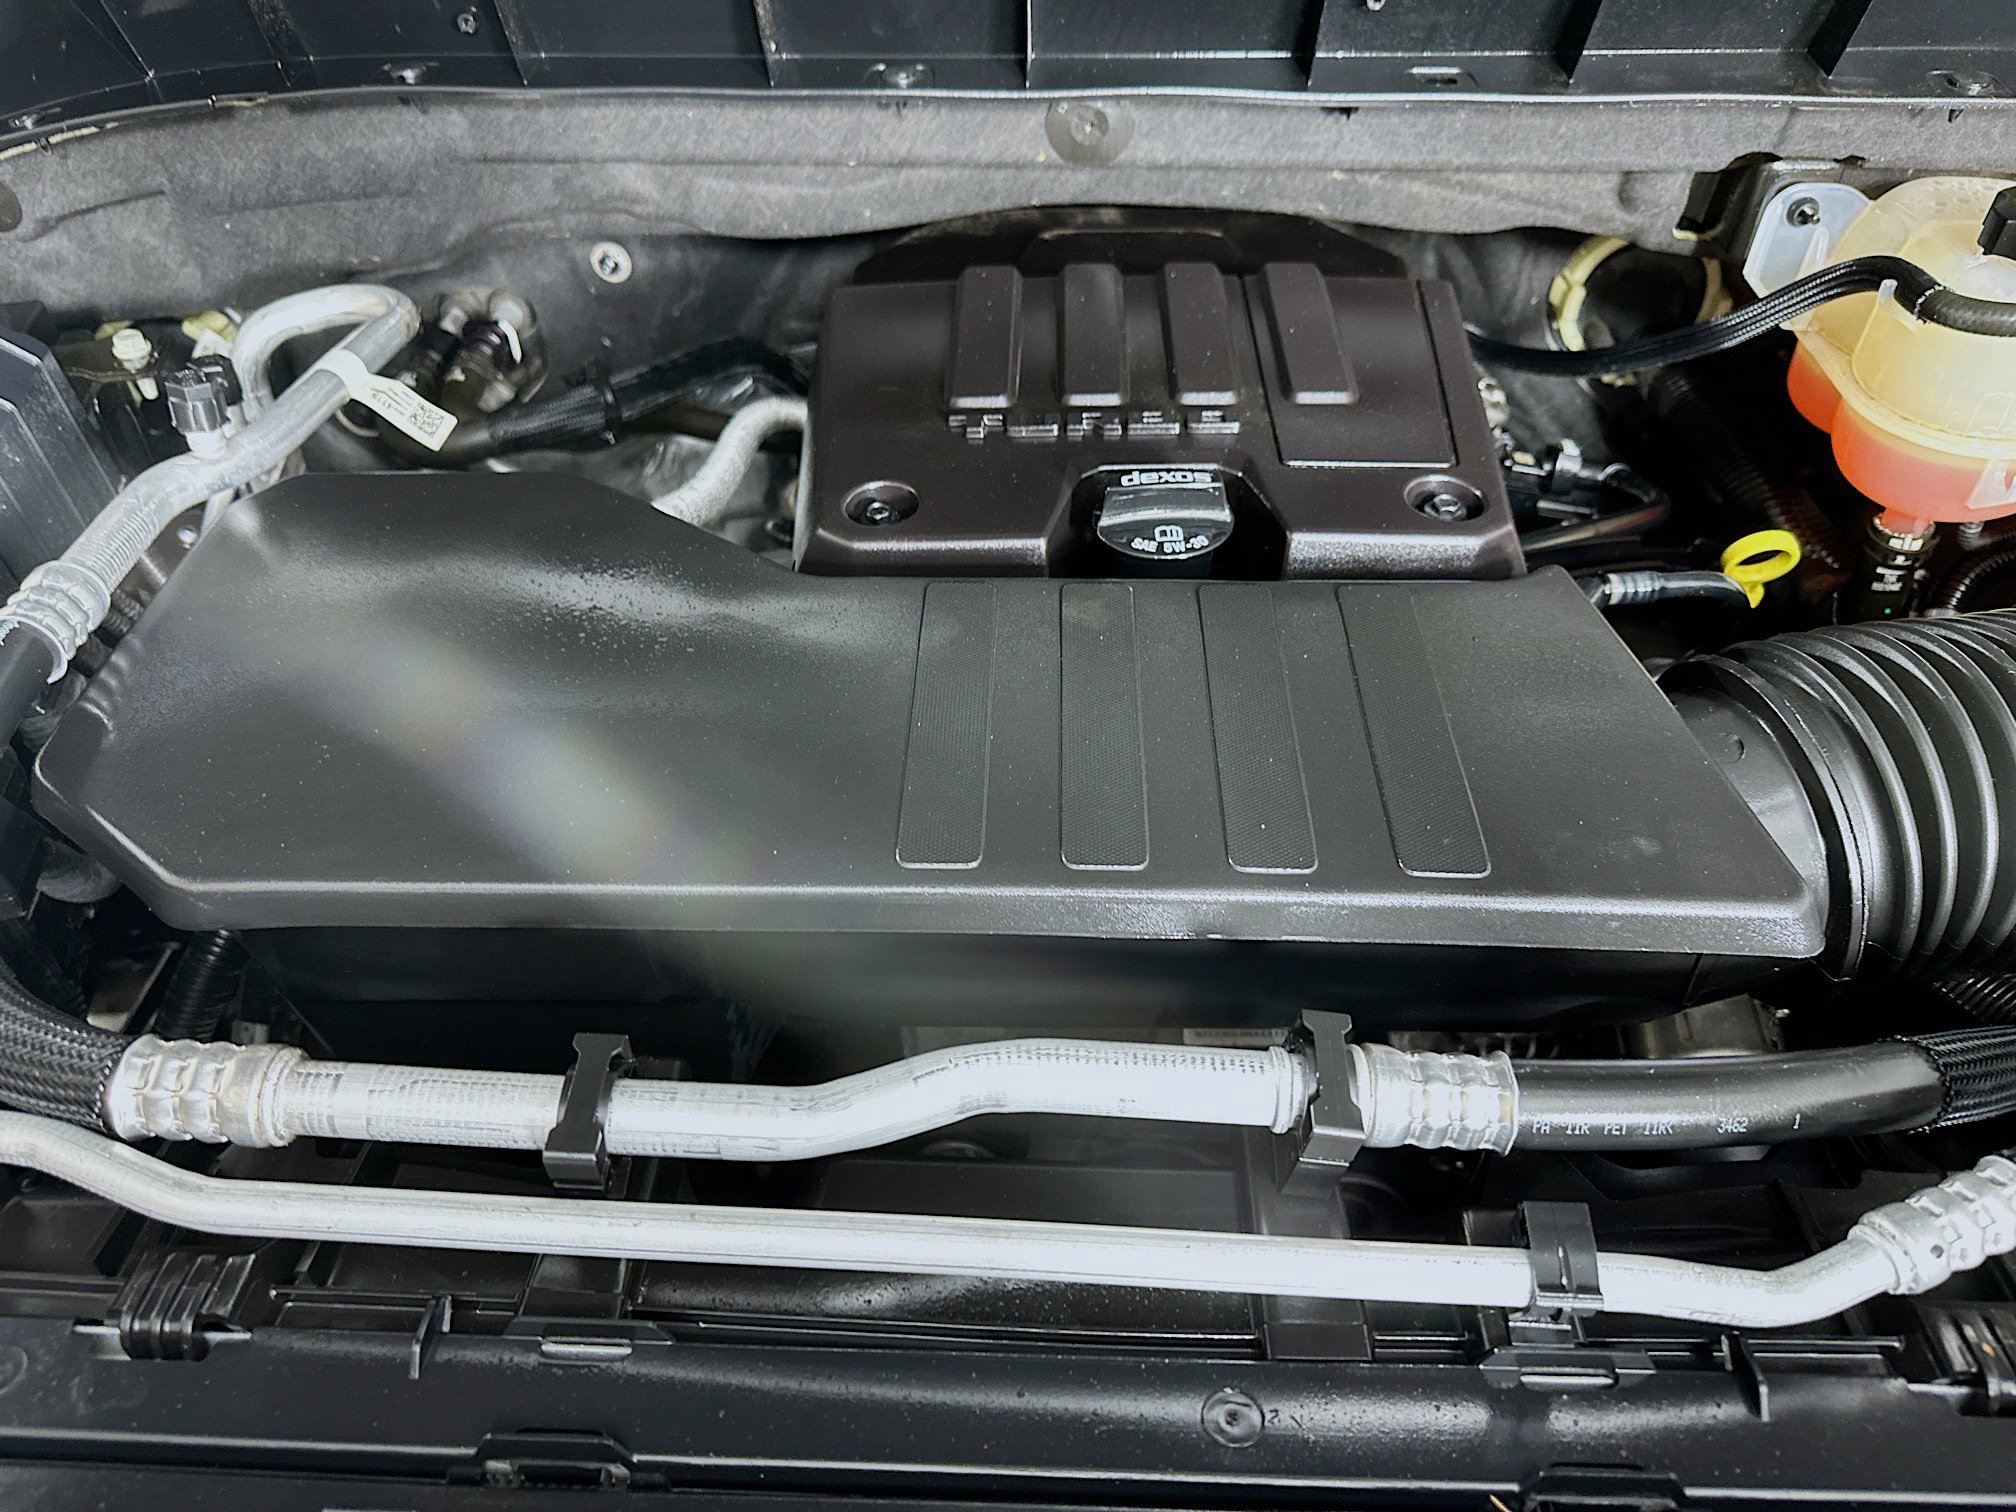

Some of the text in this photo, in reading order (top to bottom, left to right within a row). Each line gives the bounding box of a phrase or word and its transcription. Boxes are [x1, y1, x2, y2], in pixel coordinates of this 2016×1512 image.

[1120, 471, 1213, 487] dexos
[1130, 534, 1209, 554] SAE 5W-30
[1717, 1116, 1748, 1133] 3462
